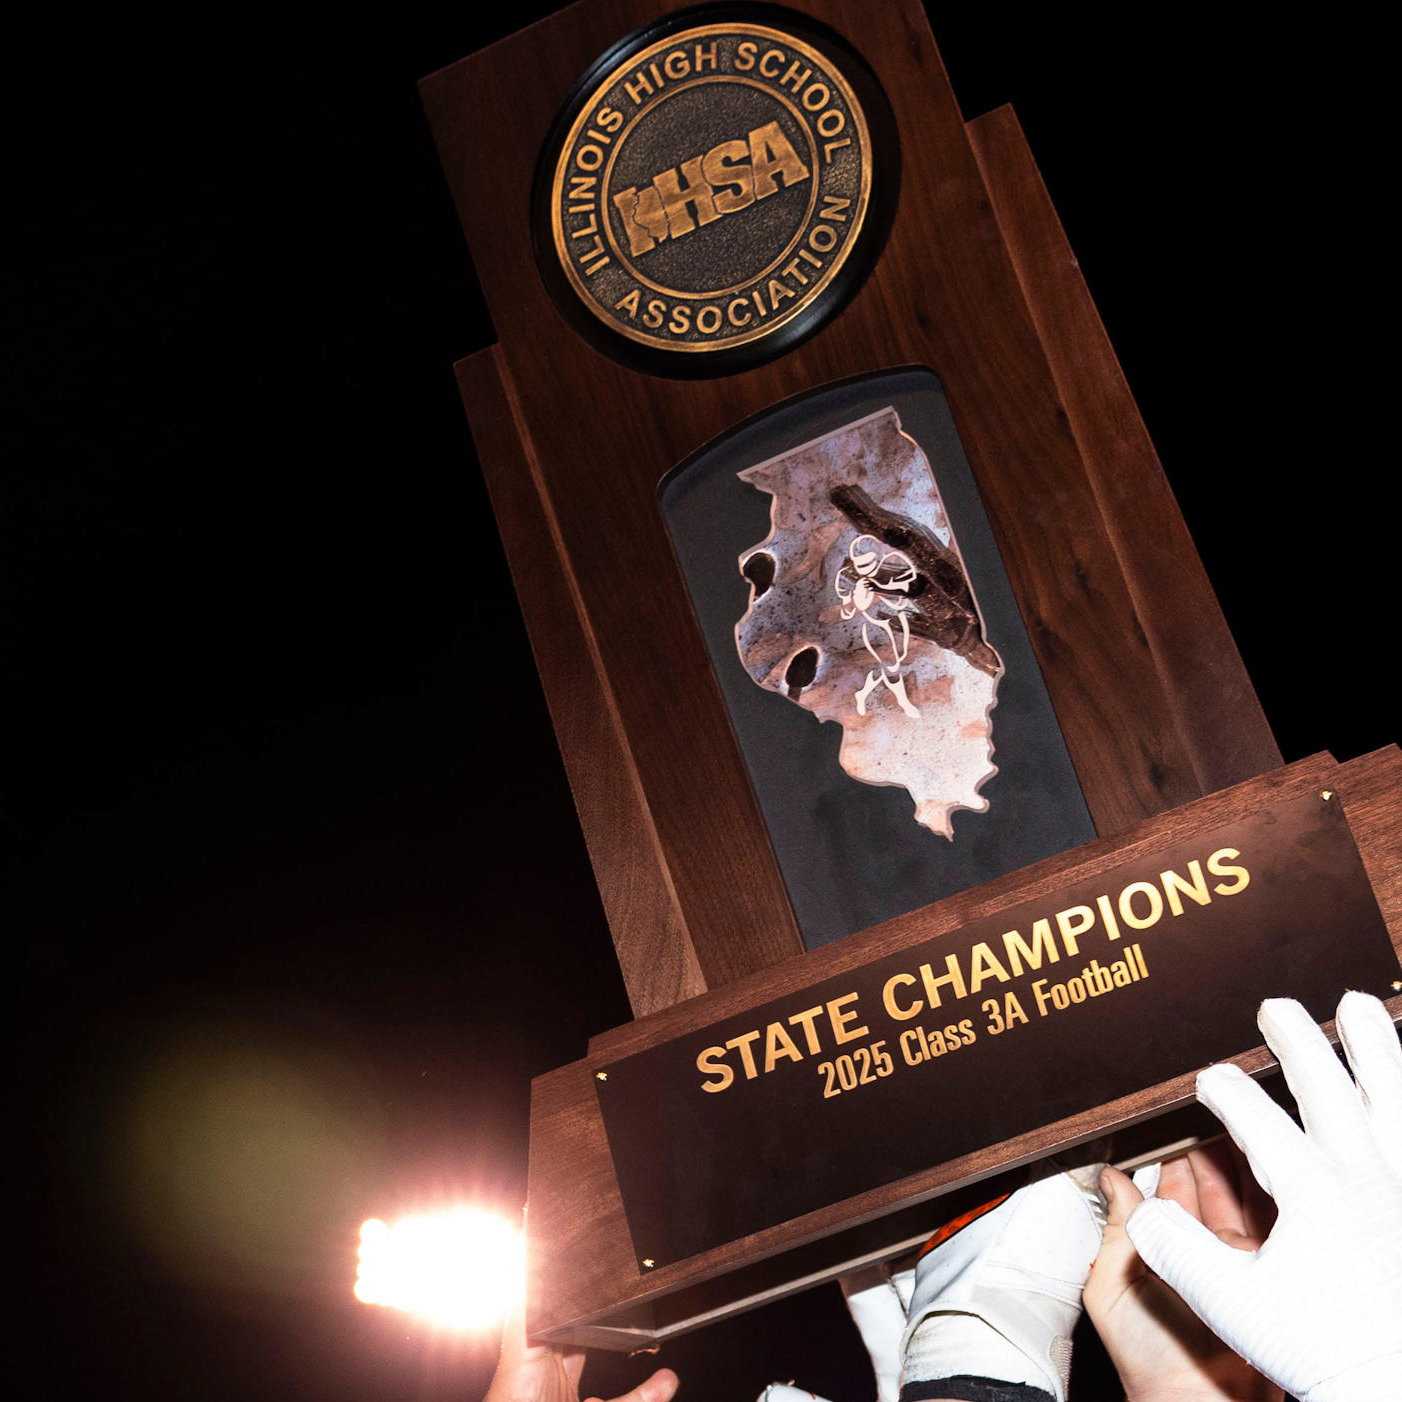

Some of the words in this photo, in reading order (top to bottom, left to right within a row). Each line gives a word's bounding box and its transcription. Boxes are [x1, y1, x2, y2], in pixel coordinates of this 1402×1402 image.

[569, 106, 624, 276] ILLINOIS
[623, 42, 718, 106] HIGH
[734, 42, 852, 165] SCHOOL
[614, 195, 851, 335] ASSOCIATION
[695, 991, 870, 1095] STATE
[881, 846, 1252, 1025] CHAMPIONS
[817, 1049, 895, 1100] 2025
[898, 1017, 977, 1068] Class
[985, 996, 1029, 1037] 3A
[1034, 944, 1149, 1018] Football
